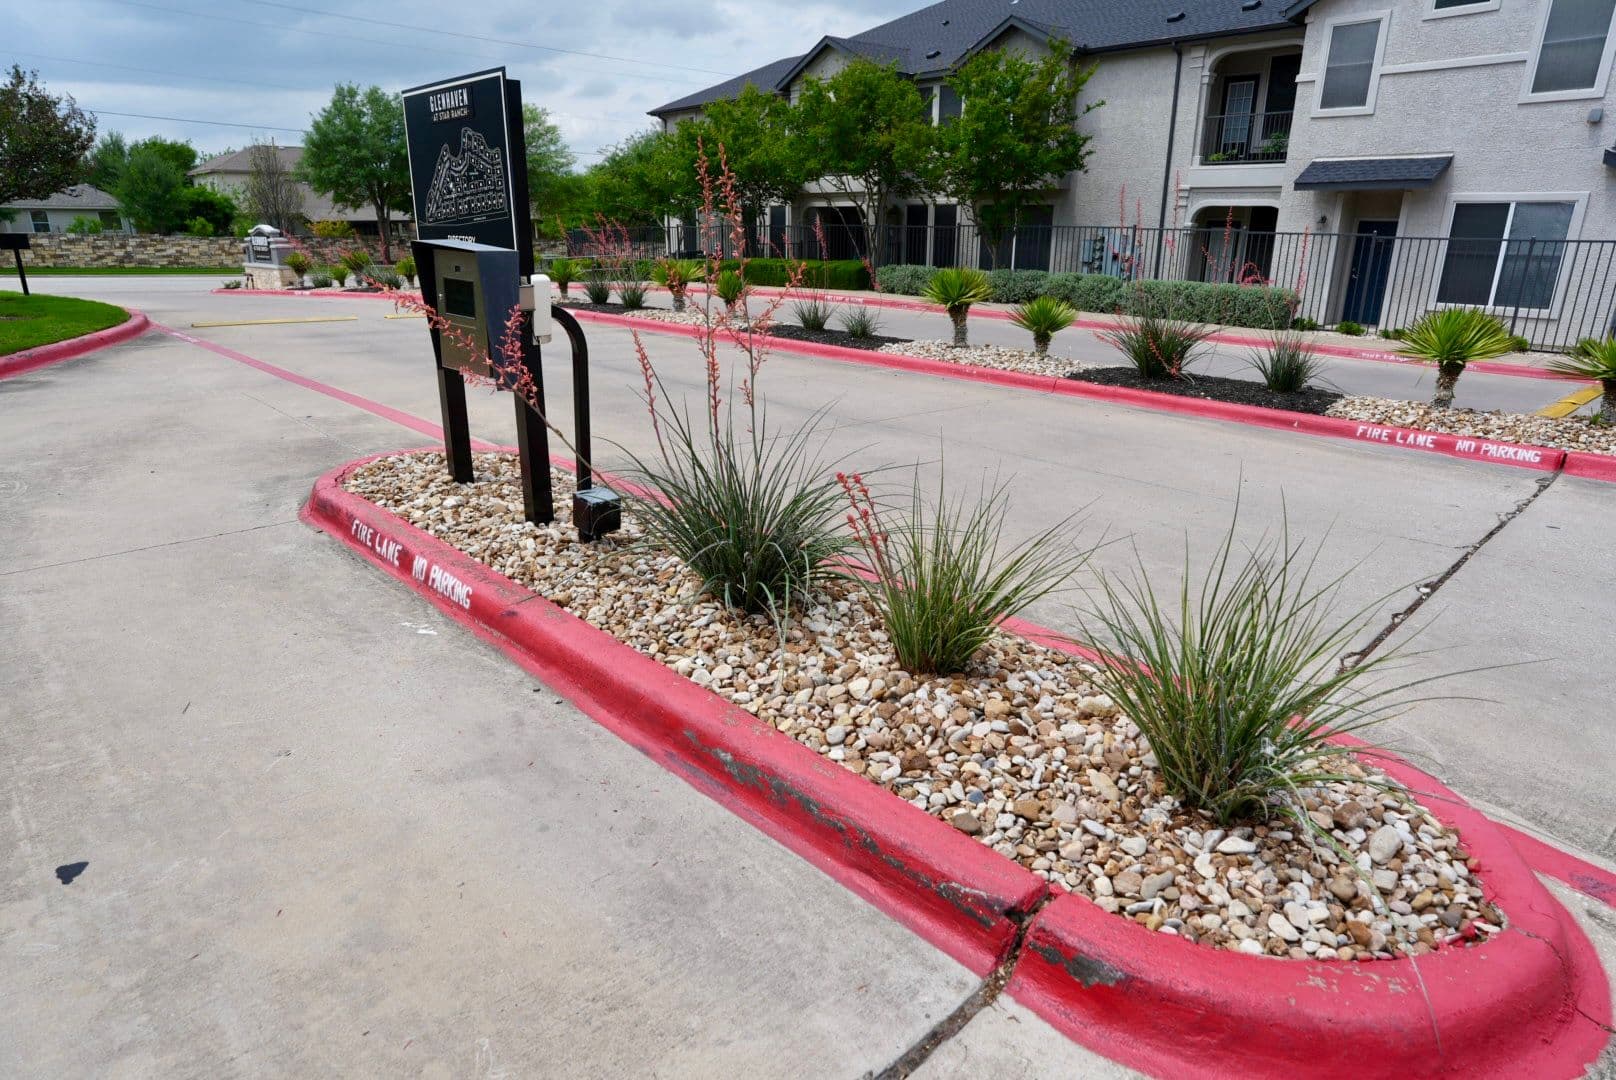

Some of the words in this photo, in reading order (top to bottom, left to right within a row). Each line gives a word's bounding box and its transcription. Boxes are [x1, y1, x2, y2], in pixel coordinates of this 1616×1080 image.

[430, 88, 469, 112] GLENHAVEN
[447, 234, 476, 243] DIRECTORY
[1356, 425, 1391, 441] FIRE
[1396, 431, 1437, 448] LANE
[1456, 440, 1475, 452] NO
[1480, 443, 1542, 463] PARKING
[351, 519, 374, 547] FIRE
[375, 533, 402, 567] LANE
[412, 554, 428, 581] NO
[428, 564, 473, 609] PARKING
